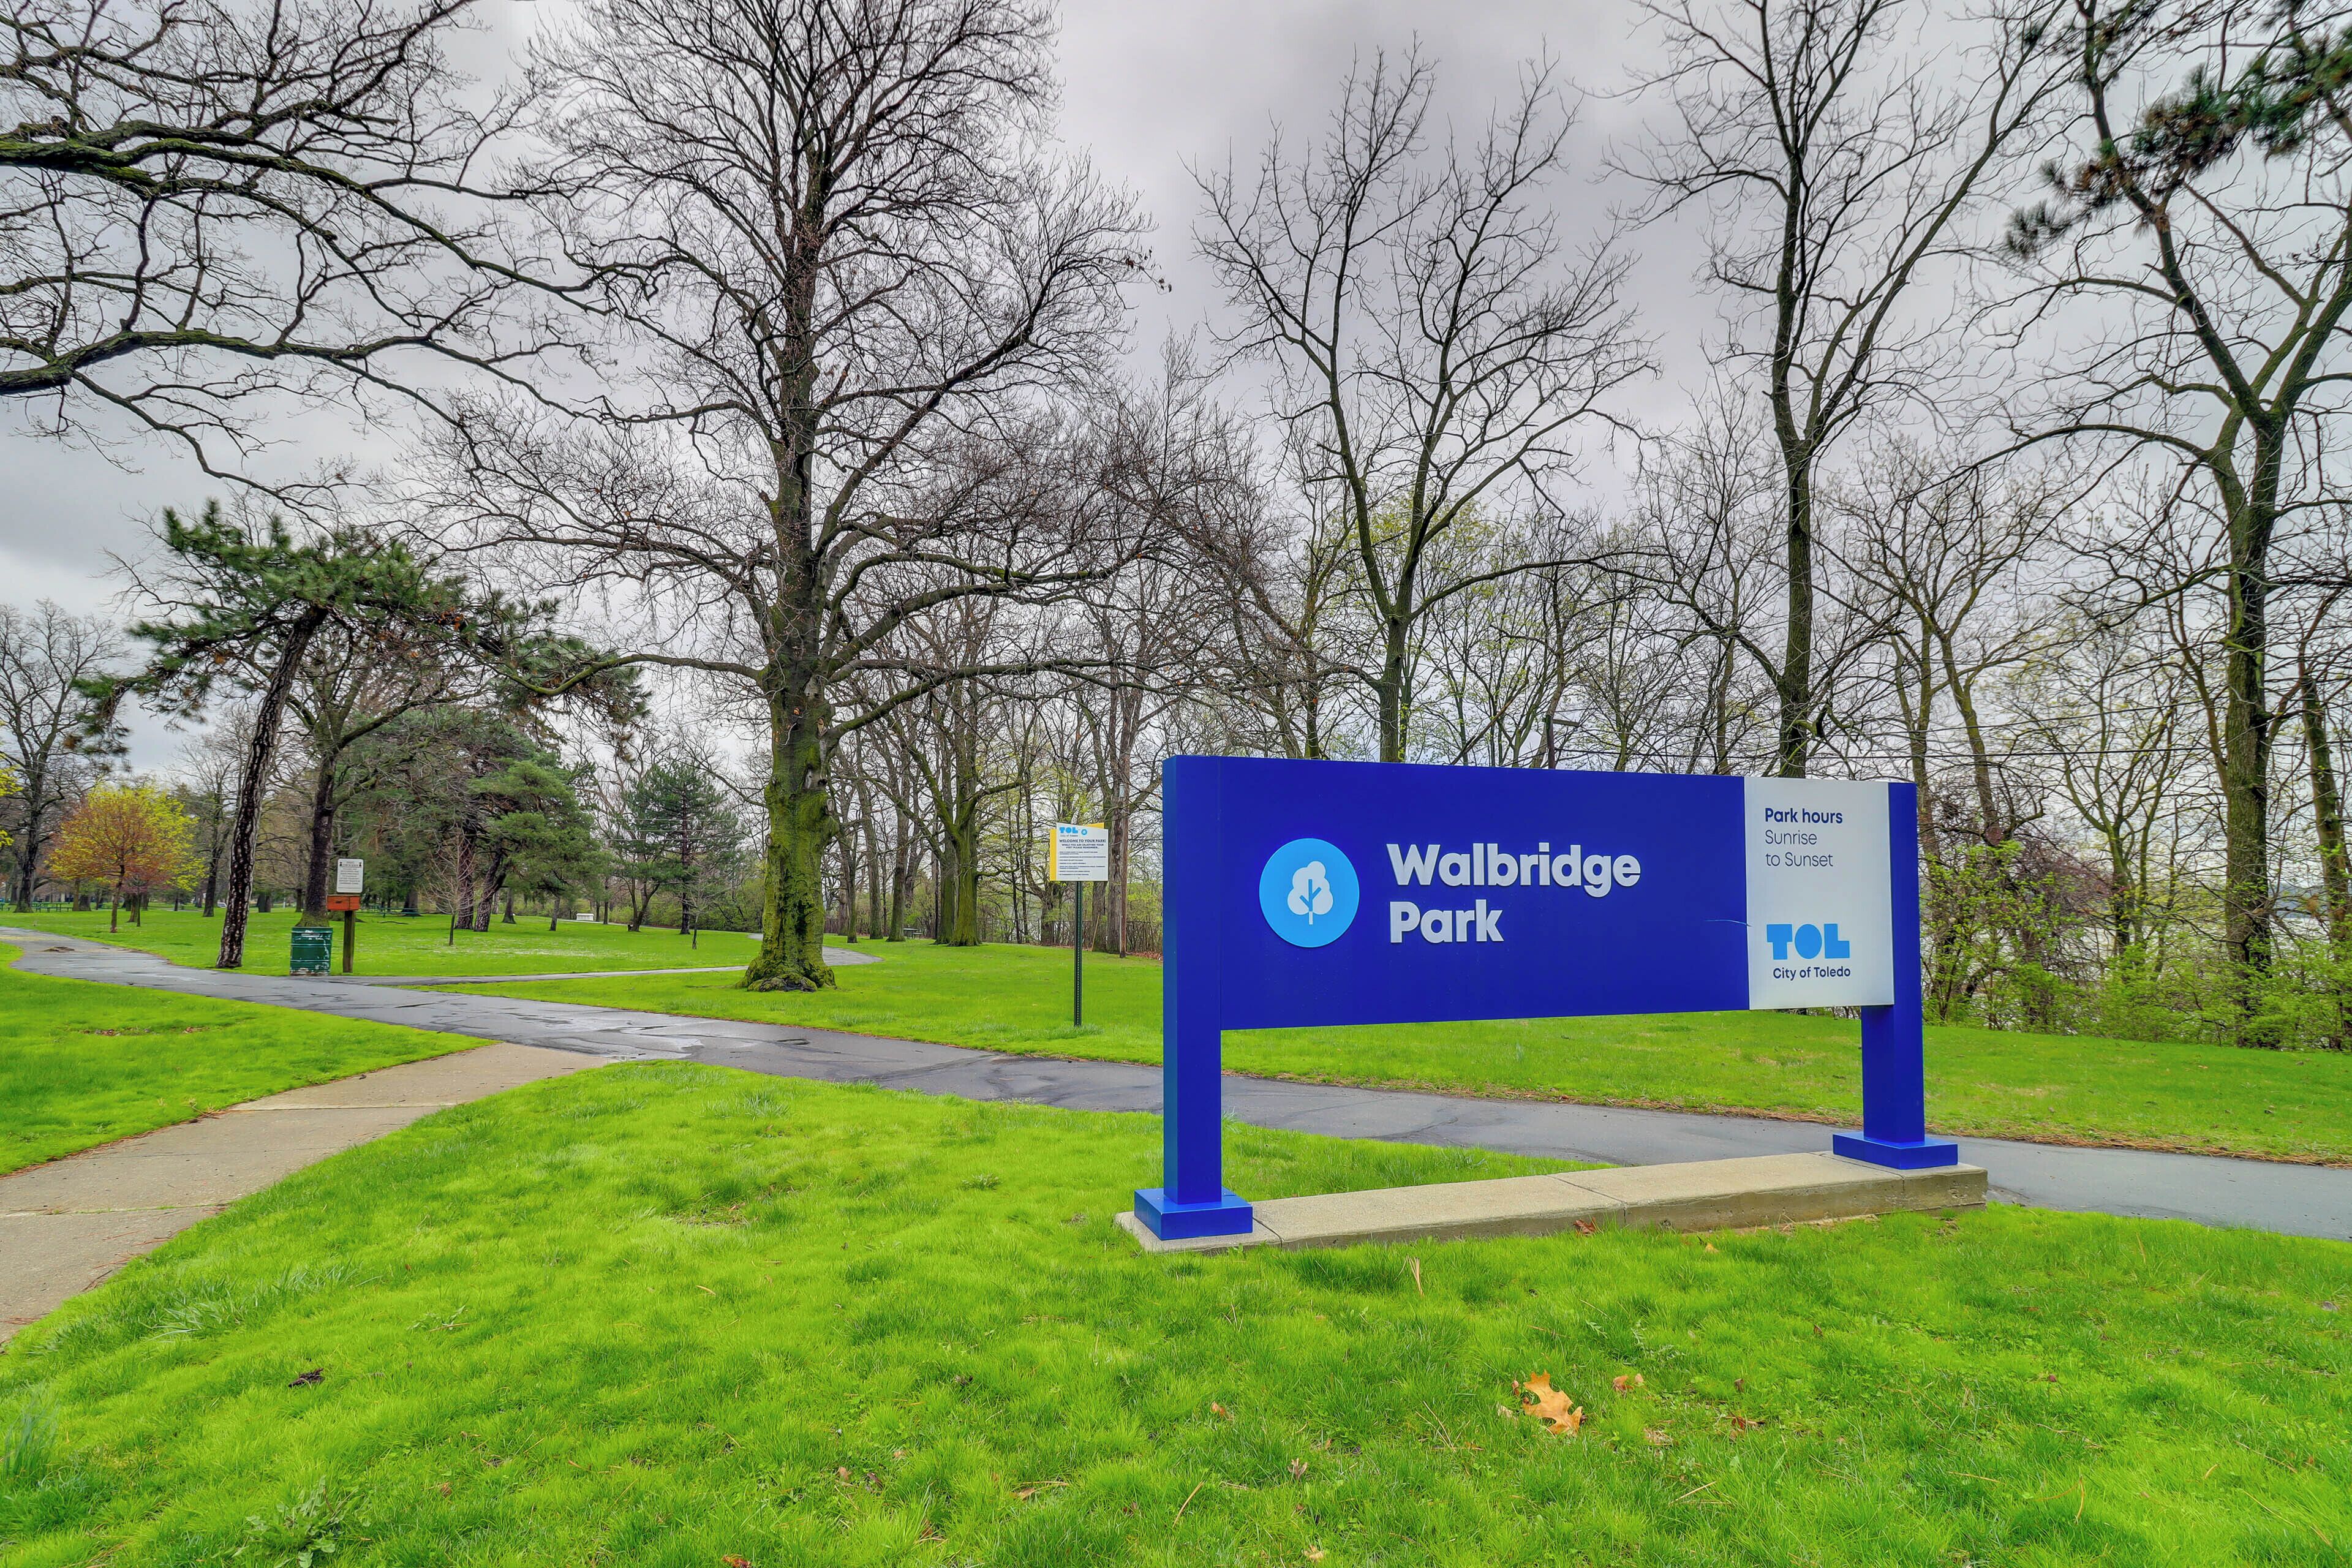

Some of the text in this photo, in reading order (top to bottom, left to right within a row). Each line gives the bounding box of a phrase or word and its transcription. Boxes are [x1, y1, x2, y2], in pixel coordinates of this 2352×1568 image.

[1765, 807, 1843, 824] Park hours
[1765, 829, 1817, 845] Sunrise
[1765, 851, 1833, 867] to Sunset
[1386, 842, 1642, 898] Walbridge
[1390, 899, 1504, 943] Park
[1766, 923, 1850, 960] TOL
[1773, 966, 1851, 981] City of Toledo
